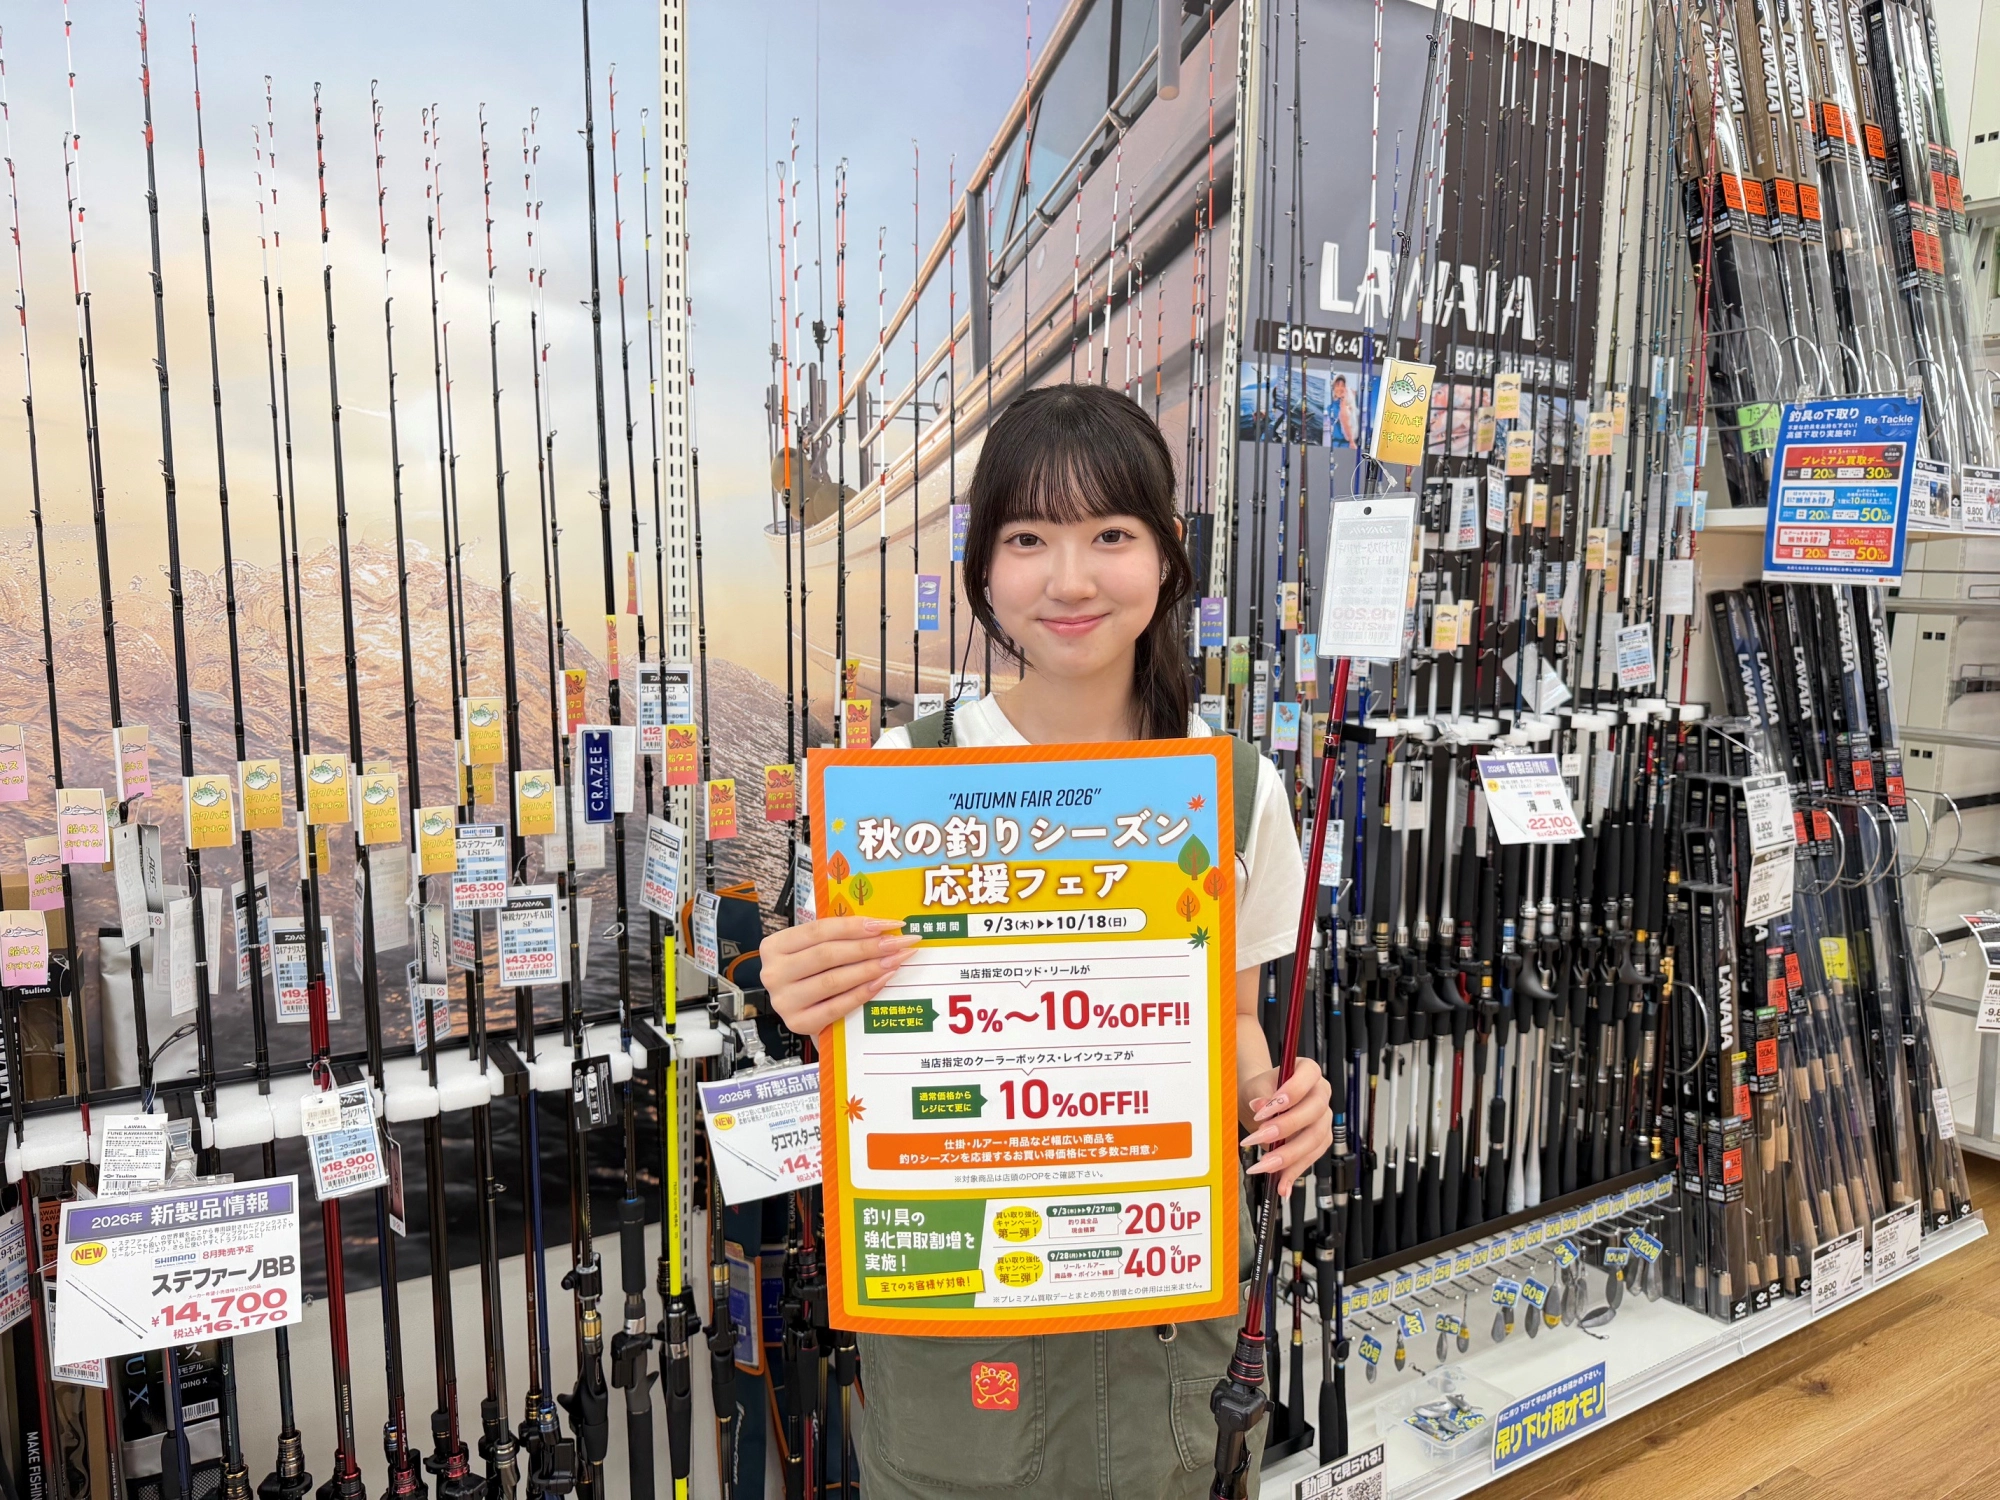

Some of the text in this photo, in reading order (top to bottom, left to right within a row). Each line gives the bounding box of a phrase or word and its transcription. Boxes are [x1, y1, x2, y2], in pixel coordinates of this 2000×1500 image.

[1849, 2, 1867, 65] AWAIA
[1721, 29, 1745, 113] LAWAIA
[1759, 24, 1781, 113] LAWAIA
[1783, 32, 1804, 118] LAWAIA
[1319, 242, 1536, 341] LAWAIA
[1277, 327, 1326, 353] BOAT
[1789, 407, 1860, 422] 釣具の下取り
[1802, 455, 1884, 466] プレミアム買取デー
[1837, 600, 1855, 673] LAWAIA
[1872, 618, 1889, 690] LAWAIA
[1738, 653, 1761, 729] LAWAIA
[1757, 652, 1779, 725] LAWAIA
[1794, 646, 1812, 720] LAWAIA
[668, 753, 693, 763] 船タコ
[1506, 760, 1550, 775] 新製品情報
[591, 745, 604, 811] CRAZEE
[309, 787, 345, 798] カワハギ
[1020, 790, 1053, 808] FAIR
[192, 810, 230, 821] カワハギ
[67, 824, 99, 835] 船キス
[857, 809, 1190, 860] 秋の釣りシーズン
[64, 839, 103, 849] おすすめ!
[455, 882, 505, 893] ¥56,300
[922, 862, 1129, 906] 応援フェア
[910, 921, 960, 934] 開催期間
[8, 945, 40, 957] 船キス
[506, 953, 554, 964] ¥43,500
[6, 960, 44, 971] おすすめ!
[959, 964, 1091, 980] 当店指定のロッド・リールが
[20, 986, 51, 996] Tsulino
[871, 1004, 924, 1016] 通常価格から
[1719, 965, 1733, 1050] LAWAIA
[872, 1017, 924, 1028] レジにて更に
[920, 1050, 1134, 1069] 当店指定のクーラーボックス・レインウェアが
[718, 1071, 820, 1104] 2026年 新製品情
[919, 1089, 972, 1101] 通常価格から
[921, 1102, 972, 1113] レジにて更に
[715, 1116, 733, 1127] NEW
[944, 1132, 1115, 1151] 仕掛・ルアー・用品など幅広い商品を
[321, 1153, 375, 1173] ¥18,900
[954, 1170, 1104, 1184] ※対象商品は店頭のPOPをご確認下さい。
[91, 1191, 268, 1229] 2026年 新製品情報
[863, 1207, 925, 1227] 釣り具の
[996, 1211, 1039, 1219] 買い取り強化
[996, 1218, 1039, 1227] キャンペーン
[864, 1230, 975, 1250] 強化買取割増を
[998, 1227, 1038, 1239] 第一弾!
[75, 1246, 104, 1261] NEW
[1491, 1246, 1507, 1262] 30号
[1511, 1238, 1525, 1253] 50号
[154, 1252, 196, 1265] SHIMANO
[202, 1244, 254, 1260] 8月発売予定
[865, 1253, 907, 1273] 実施!
[997, 1256, 1041, 1264] 買い取り強化
[1472, 1252, 1488, 1269] 30号
[997, 1264, 1041, 1272] キャンペーン
[1435, 1265, 1450, 1282] 25号
[1456, 1258, 1470, 1275] 25号
[151, 1255, 296, 1298] ステファーノBB
[880, 1276, 971, 1293] 全てのお客様が対象!
[999, 1272, 1039, 1284] 第二弾!
[1416, 1274, 1432, 1291] 25号
[1395, 1280, 1412, 1297] 20号
[1522, 1283, 1544, 1306] 60号
[1352, 1293, 1369, 1311] 15号
[1372, 1289, 1389, 1306] 20号
[151, 1288, 288, 1328] ¥14,700
[173, 1310, 288, 1339] 税込¥16,170
[1360, 1342, 1380, 1363] 20号
[1496, 1382, 1604, 1460] 吊り下げ用オモリ
[26, 1431, 42, 1500] MAKE FISHIN
[1301, 1446, 1382, 1499] 動画で見られる!
